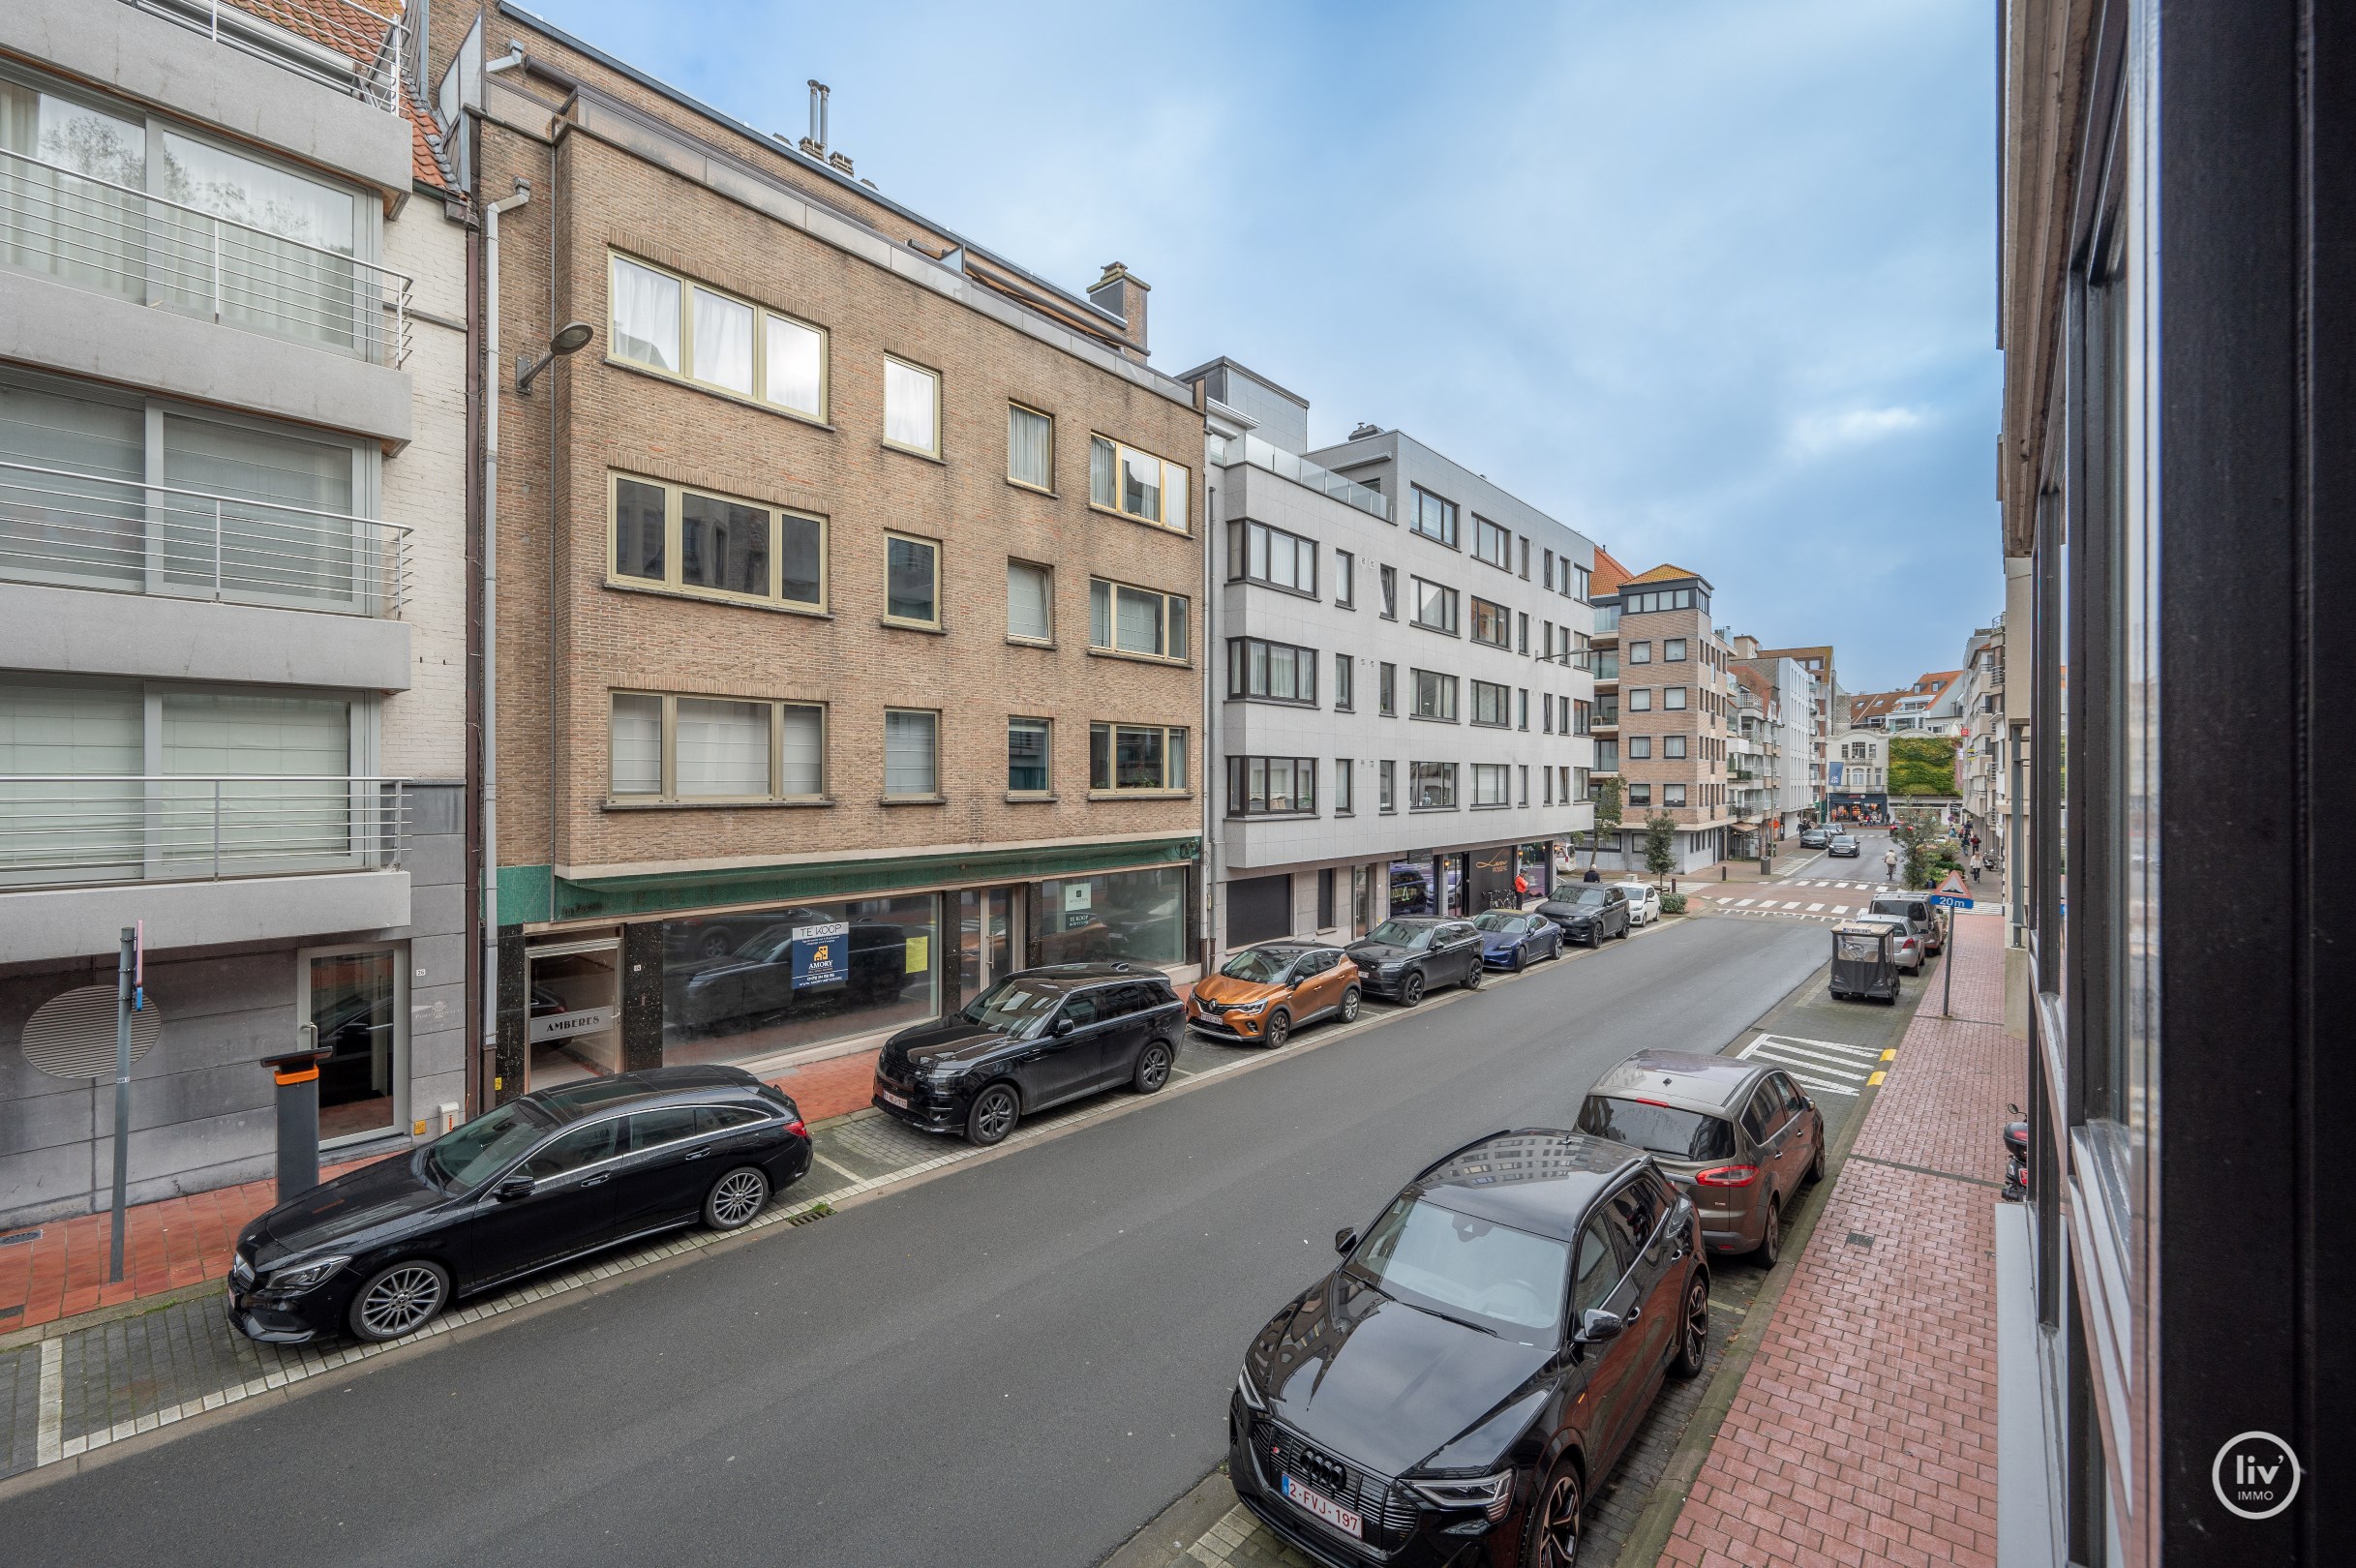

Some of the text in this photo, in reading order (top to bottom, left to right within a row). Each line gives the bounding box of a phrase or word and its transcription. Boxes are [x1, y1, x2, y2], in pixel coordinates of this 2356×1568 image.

[1939, 896, 1953, 906] 20
[800, 923, 842, 937] TE KOOP
[809, 959, 833, 970] AMORY
[546, 1015, 600, 1033] AMBERES
[1289, 1483, 1358, 1531] 2-FVJ-197
